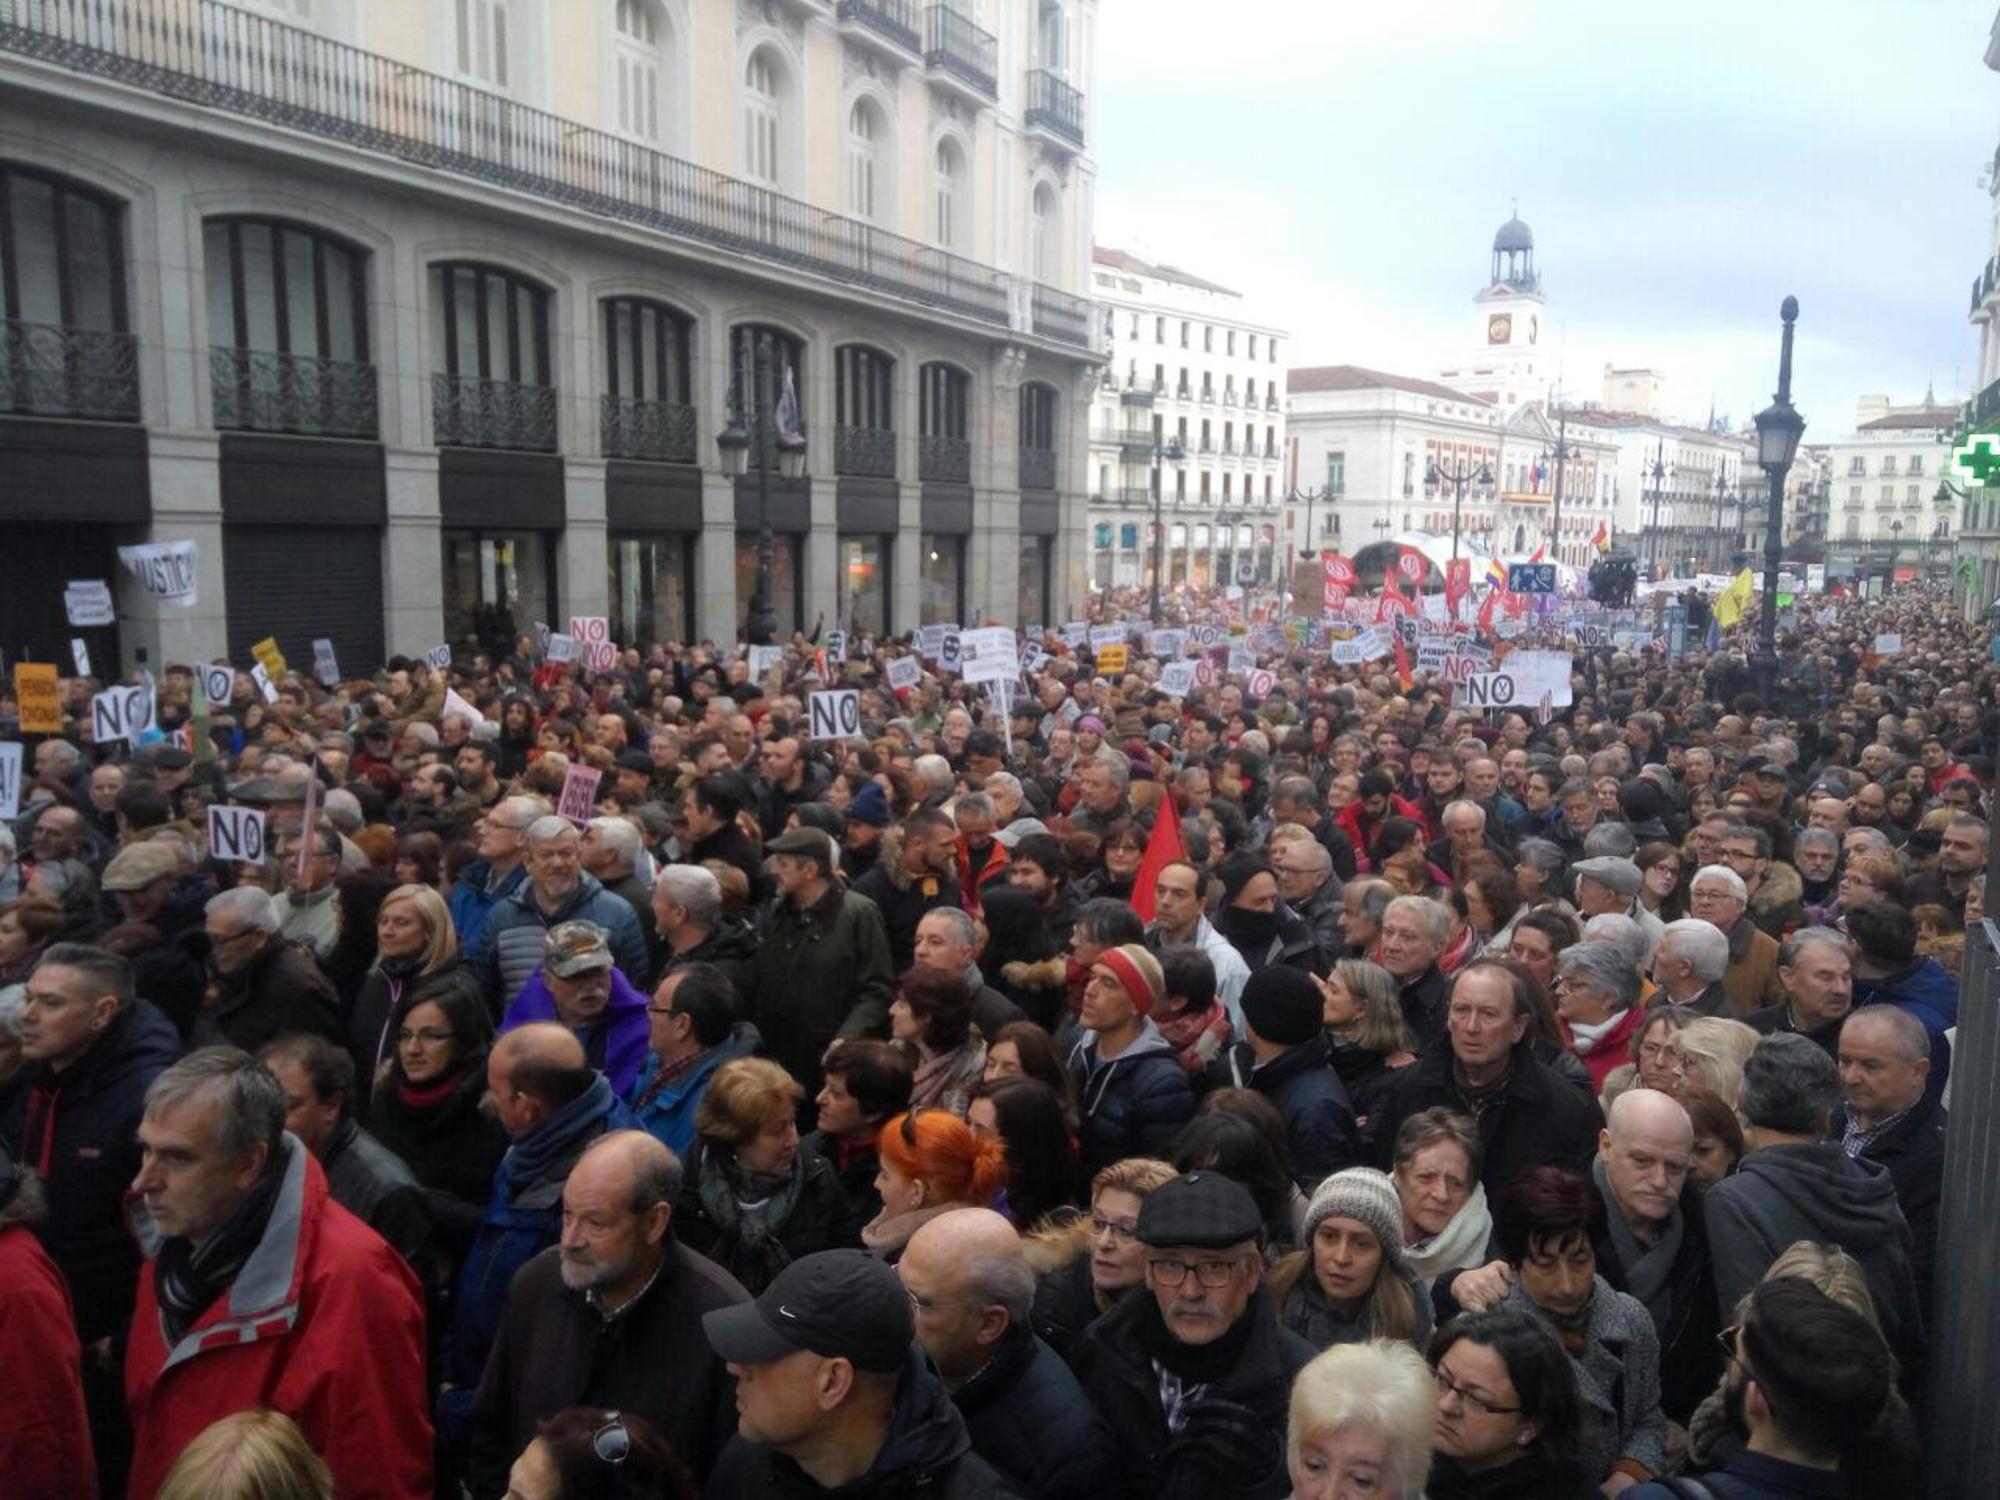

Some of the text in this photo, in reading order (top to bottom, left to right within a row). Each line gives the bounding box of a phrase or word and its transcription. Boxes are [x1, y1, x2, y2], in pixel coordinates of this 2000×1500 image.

[571, 618, 605, 640] NO
[583, 643, 613, 670] NO
[1445, 655, 1477, 682] NO
[1469, 674, 1515, 704] NO
[94, 689, 153, 739] NO
[812, 693, 857, 736] NO
[213, 810, 261, 860] NO
